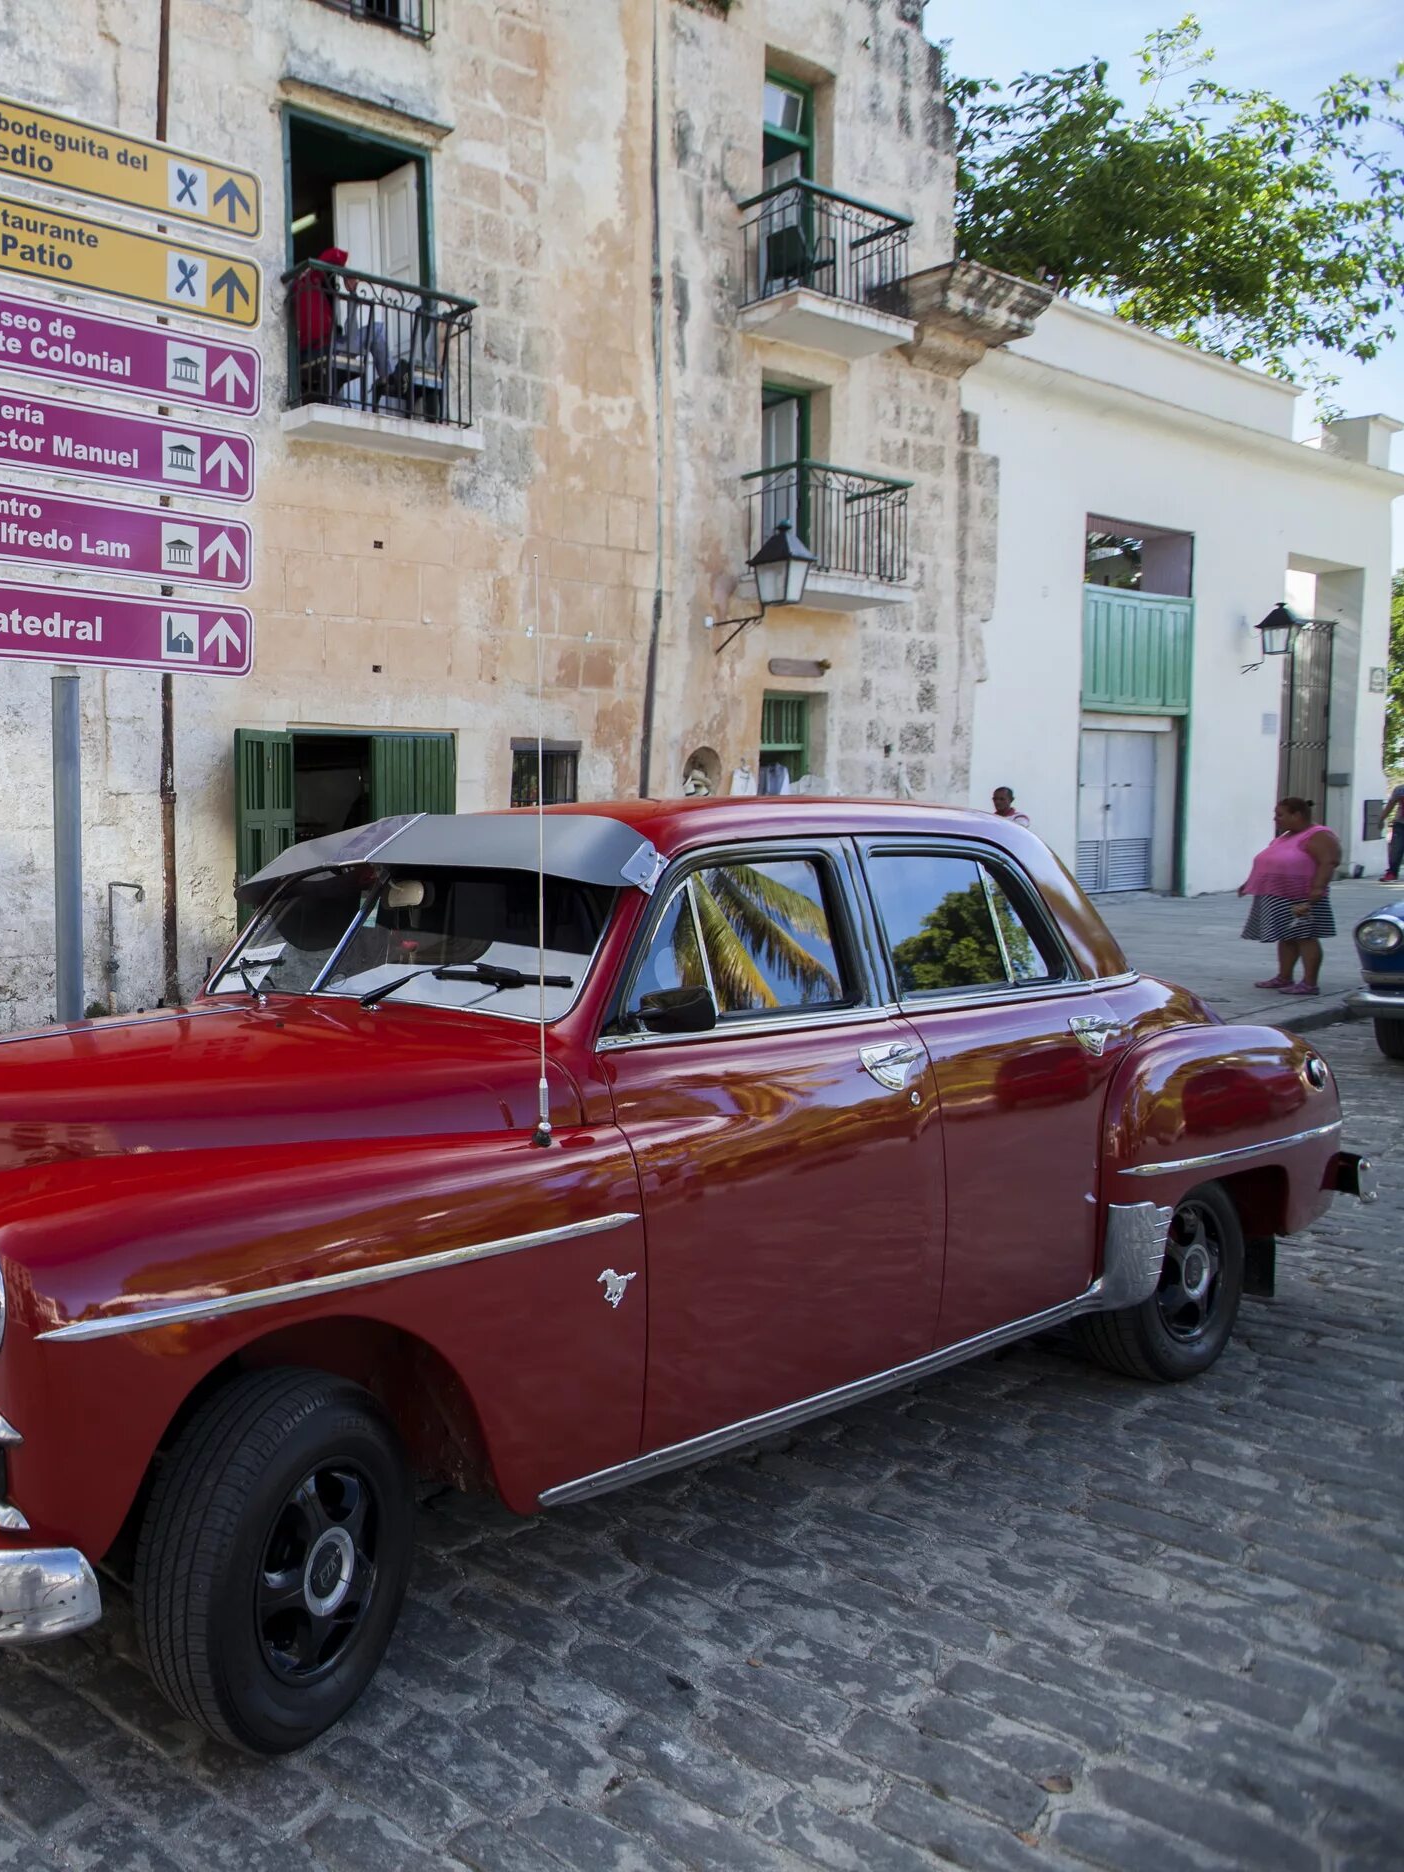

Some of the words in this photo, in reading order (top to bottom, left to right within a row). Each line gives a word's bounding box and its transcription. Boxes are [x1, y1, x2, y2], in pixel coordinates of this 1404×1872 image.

[116, 147, 148, 172] del
[1, 232, 73, 270] Patio
[48, 318, 76, 339] de
[30, 337, 131, 377] Colonial
[52, 434, 139, 469] Manuel
[81, 532, 131, 559] Lam
